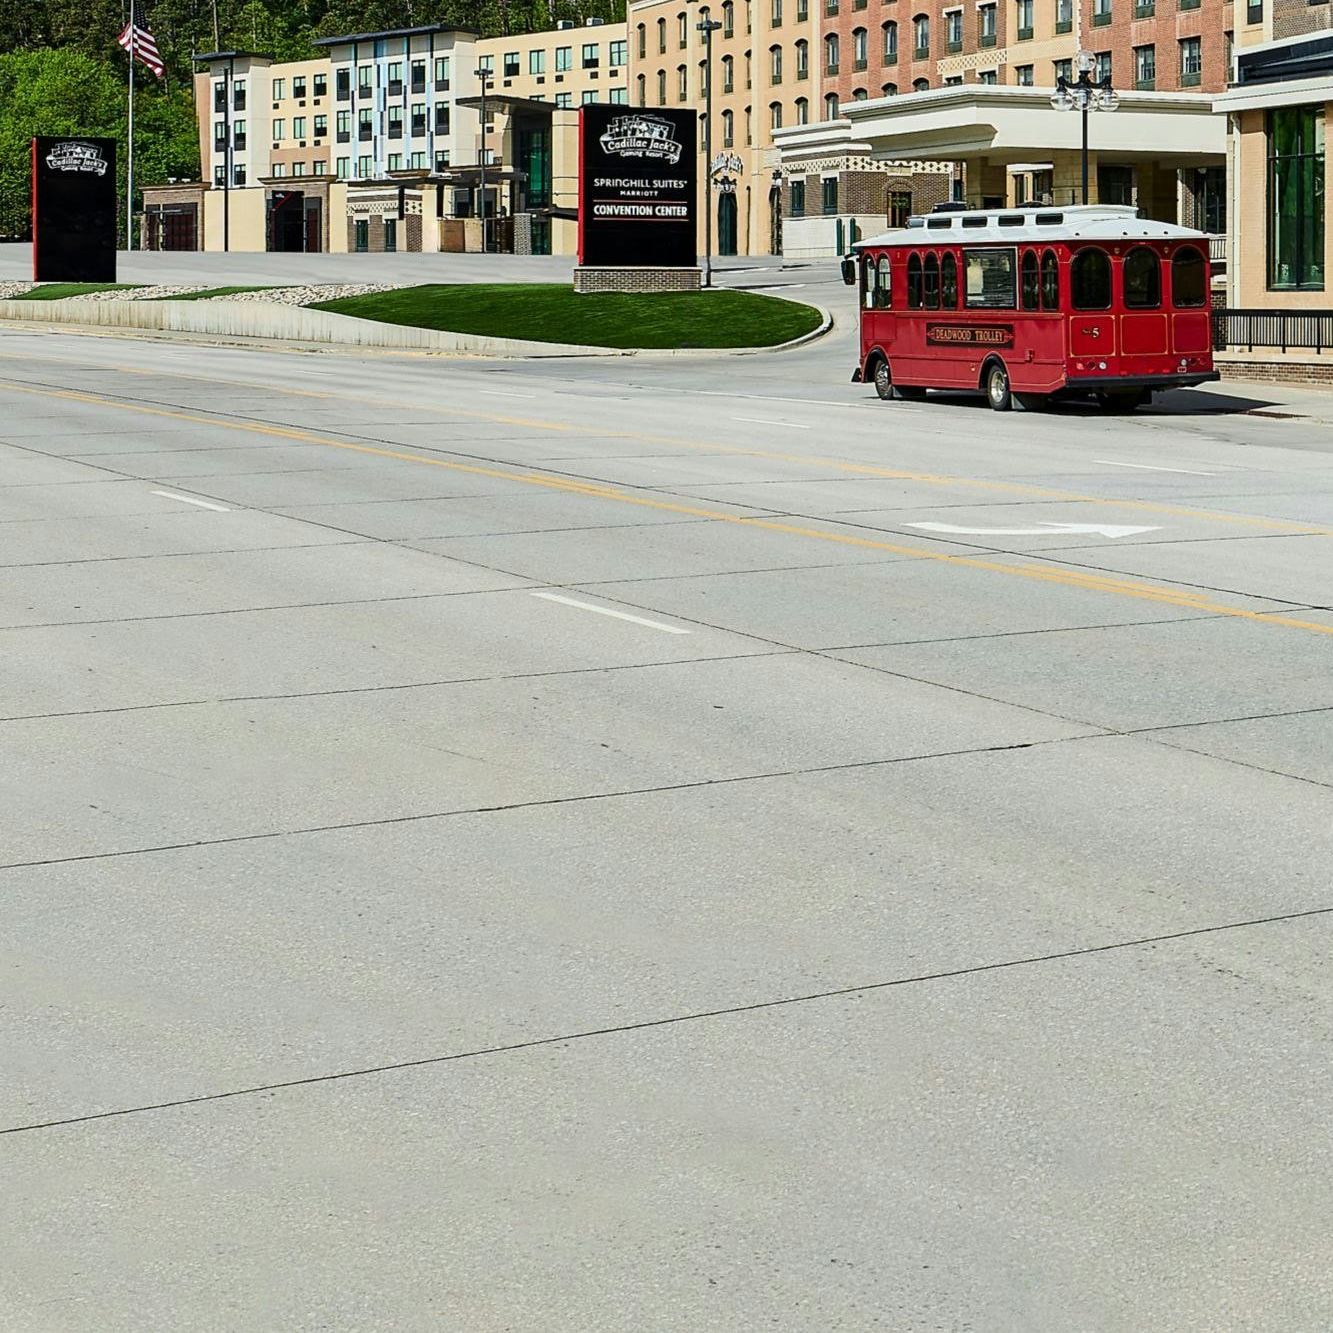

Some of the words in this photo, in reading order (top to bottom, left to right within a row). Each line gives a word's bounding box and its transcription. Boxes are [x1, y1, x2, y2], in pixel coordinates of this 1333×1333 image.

[607, 138, 648, 150] Cadillac
[649, 138, 675, 152] Jack's
[593, 177, 651, 188] SPRINGHILL
[593, 204, 653, 216] CONVENTION
[655, 205, 688, 217] CENTER
[935, 329, 972, 341] DEADWOOD
[974, 330, 1004, 342] TROLLEY
[1092, 327, 1099, 338] 5
